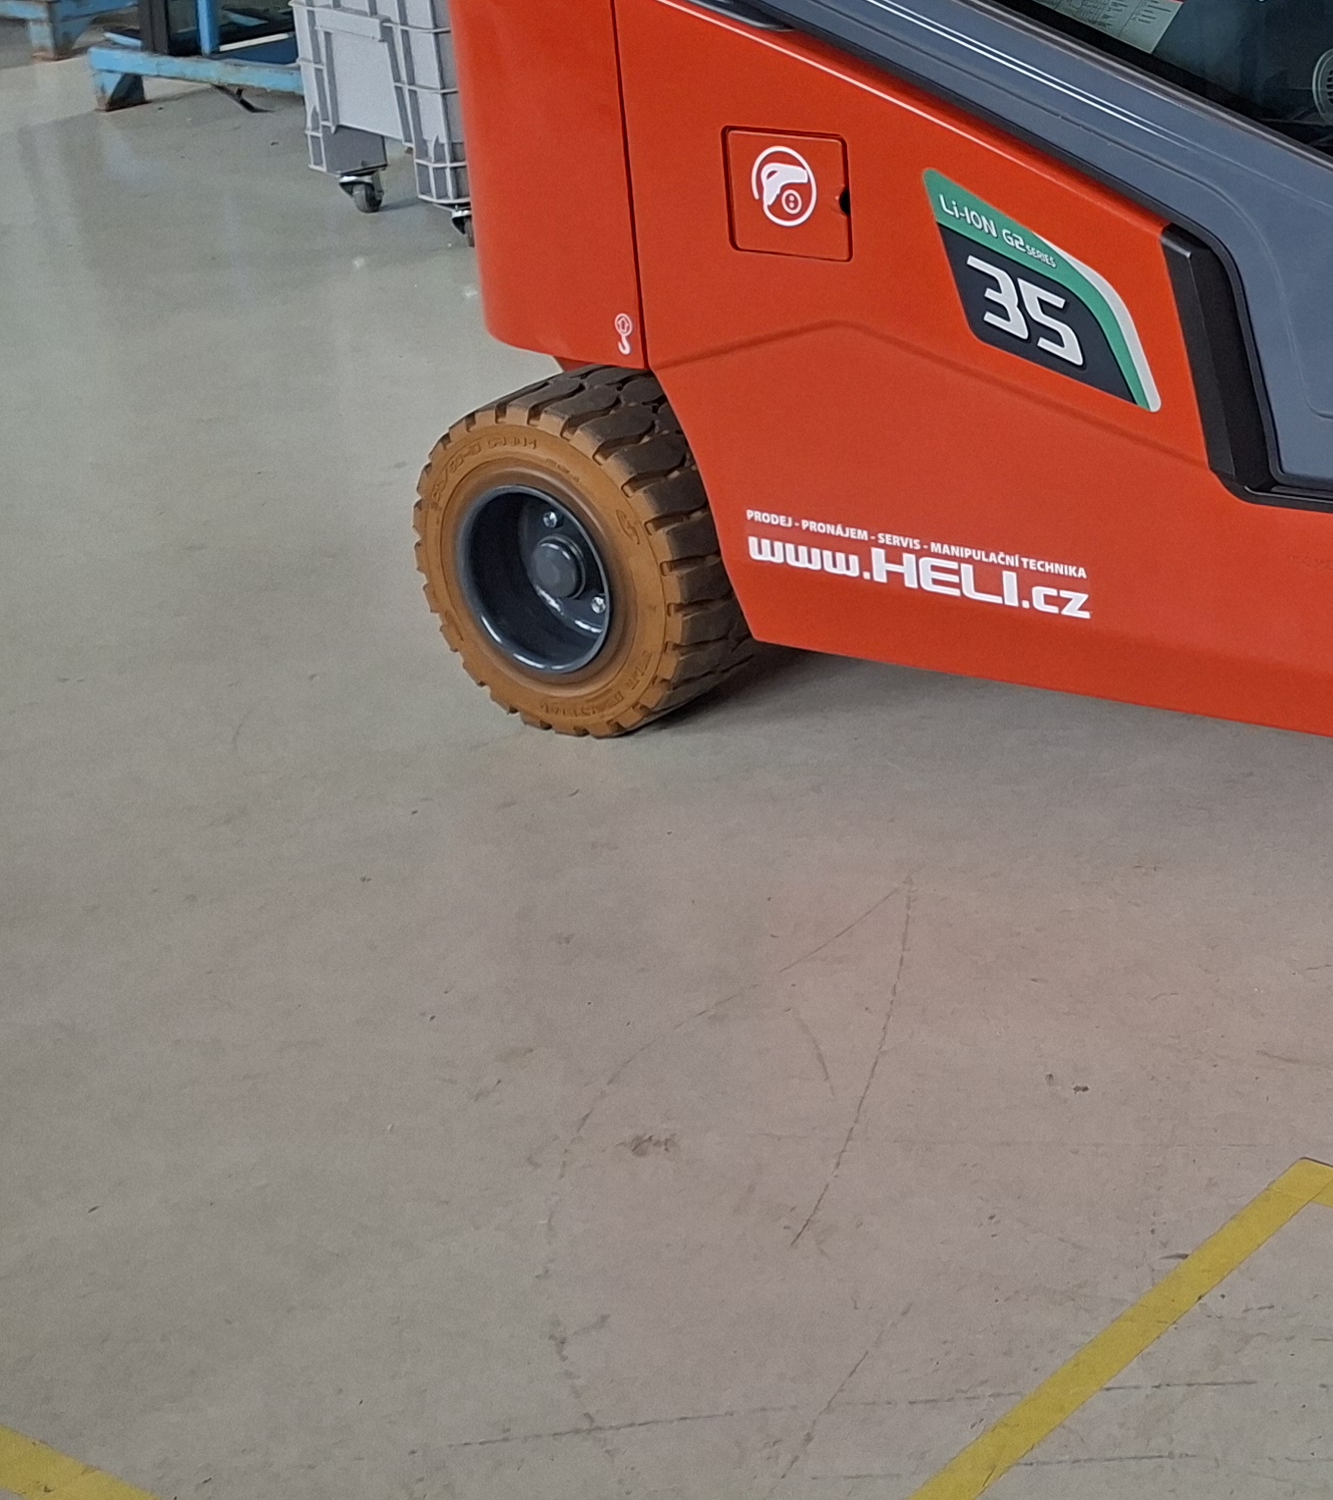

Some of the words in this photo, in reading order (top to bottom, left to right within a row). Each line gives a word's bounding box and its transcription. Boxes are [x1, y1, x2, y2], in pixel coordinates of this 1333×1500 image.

[1002, 229, 1027, 252] G2
[1025, 245, 1057, 268] SERIES
[966, 255, 1084, 366] 35
[746, 509, 793, 528] PRODEJ
[801, 519, 869, 541] PRONÁJEM
[877, 532, 921, 550] SERVIS
[930, 542, 1020, 567] MANIPULAČNÍ
[1020, 557, 1087, 579] TECHNIKA
[748, 536, 1091, 619] www.HELI.cz
